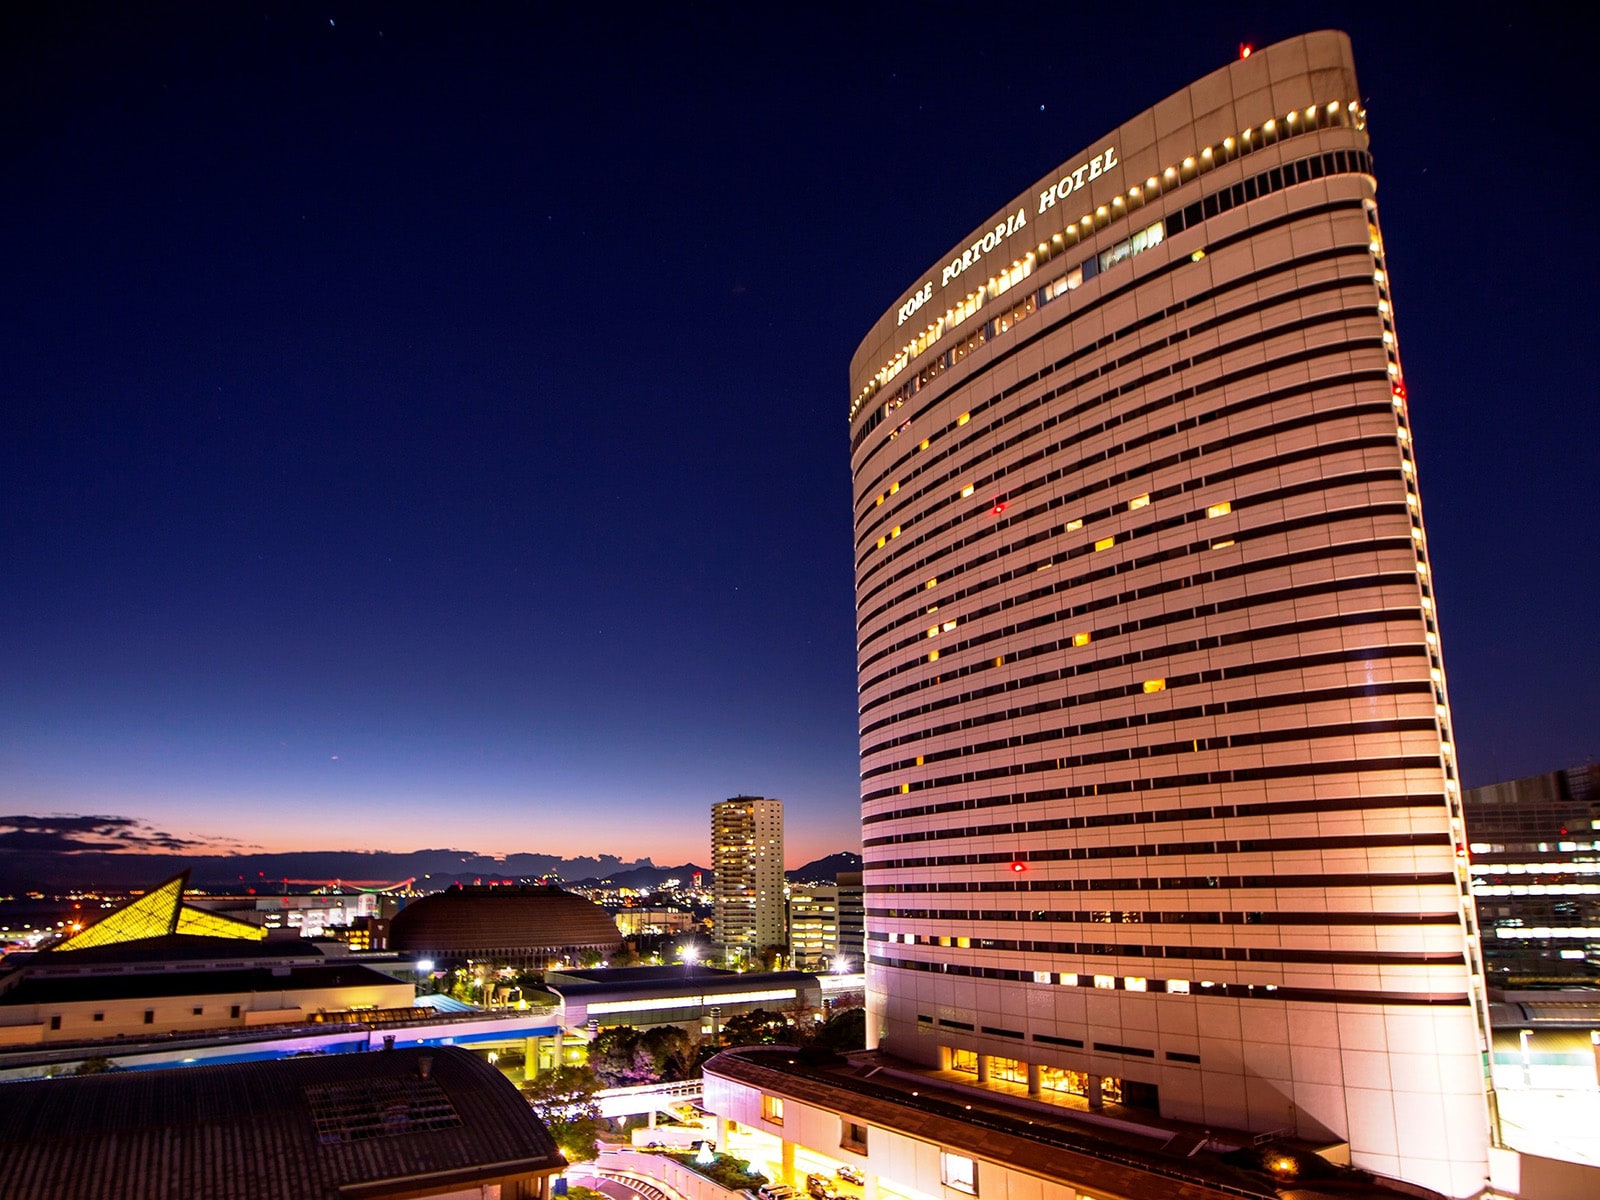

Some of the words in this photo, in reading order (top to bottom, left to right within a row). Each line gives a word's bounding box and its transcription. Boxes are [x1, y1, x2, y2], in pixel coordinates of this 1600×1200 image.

[898, 282, 933, 326] KOBE
[941, 208, 1027, 287] PORTOPIA
[1038, 147, 1118, 214] HOTEL
